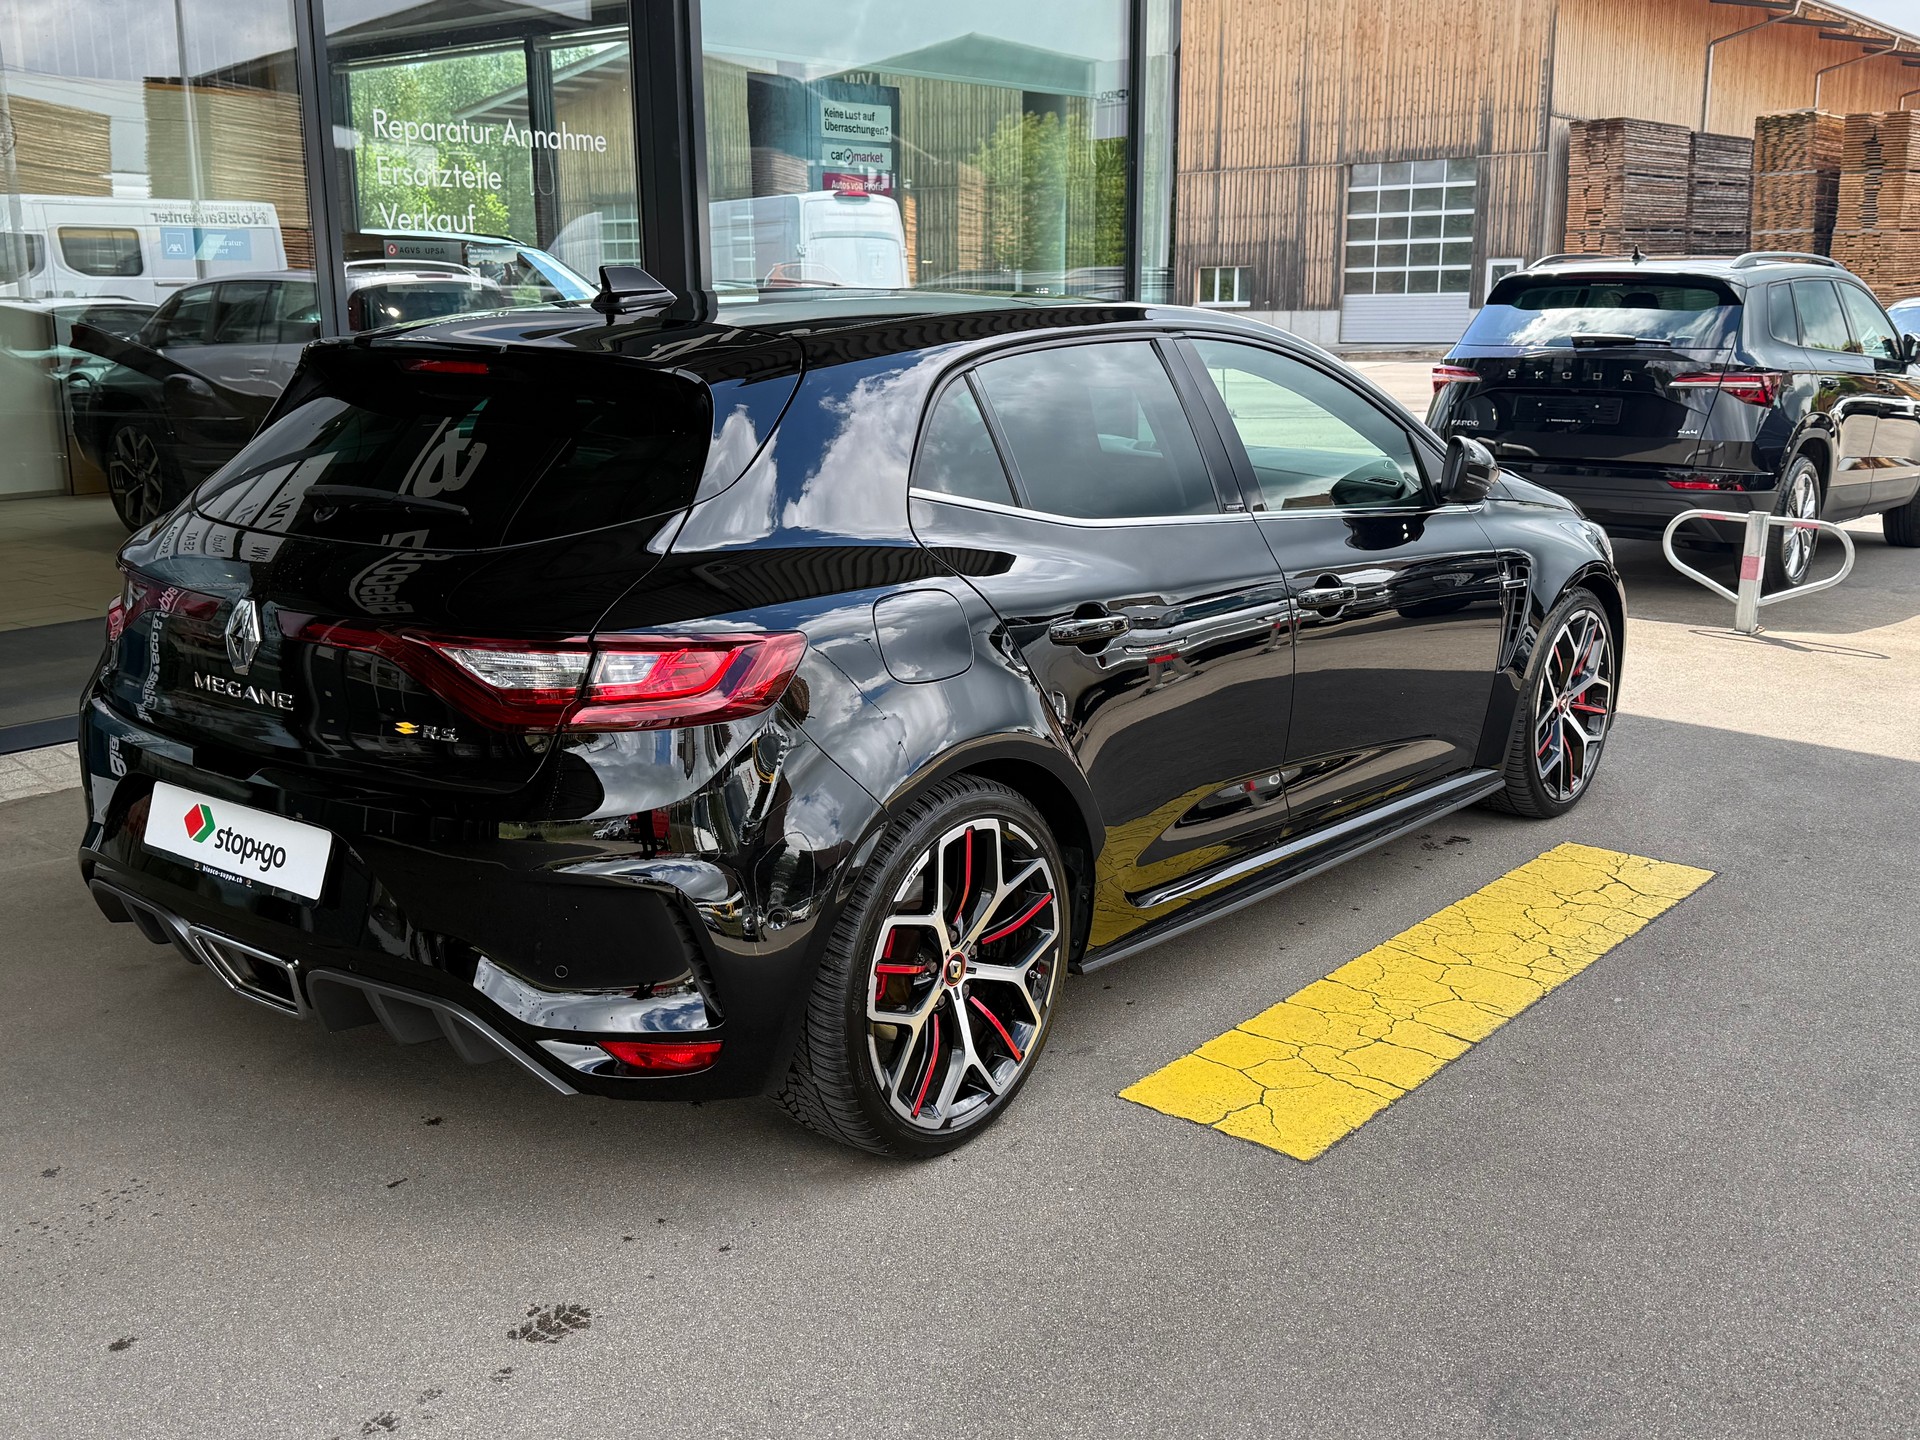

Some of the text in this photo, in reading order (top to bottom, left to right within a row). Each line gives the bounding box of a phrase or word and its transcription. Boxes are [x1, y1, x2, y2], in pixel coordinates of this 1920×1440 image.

[824, 107, 875, 121] Keine Lust auf
[824, 119, 889, 136] Überraschungen?
[372, 108, 607, 152] Reparatur Annahme
[376, 156, 502, 190] Ersatzteile
[832, 180, 850, 190] Autos
[379, 202, 476, 233] Verkauf
[194, 671, 294, 712] MEGANE
[214, 826, 286, 872] stop+go
[202, 864, 243, 884] biasco-suppa.ch
